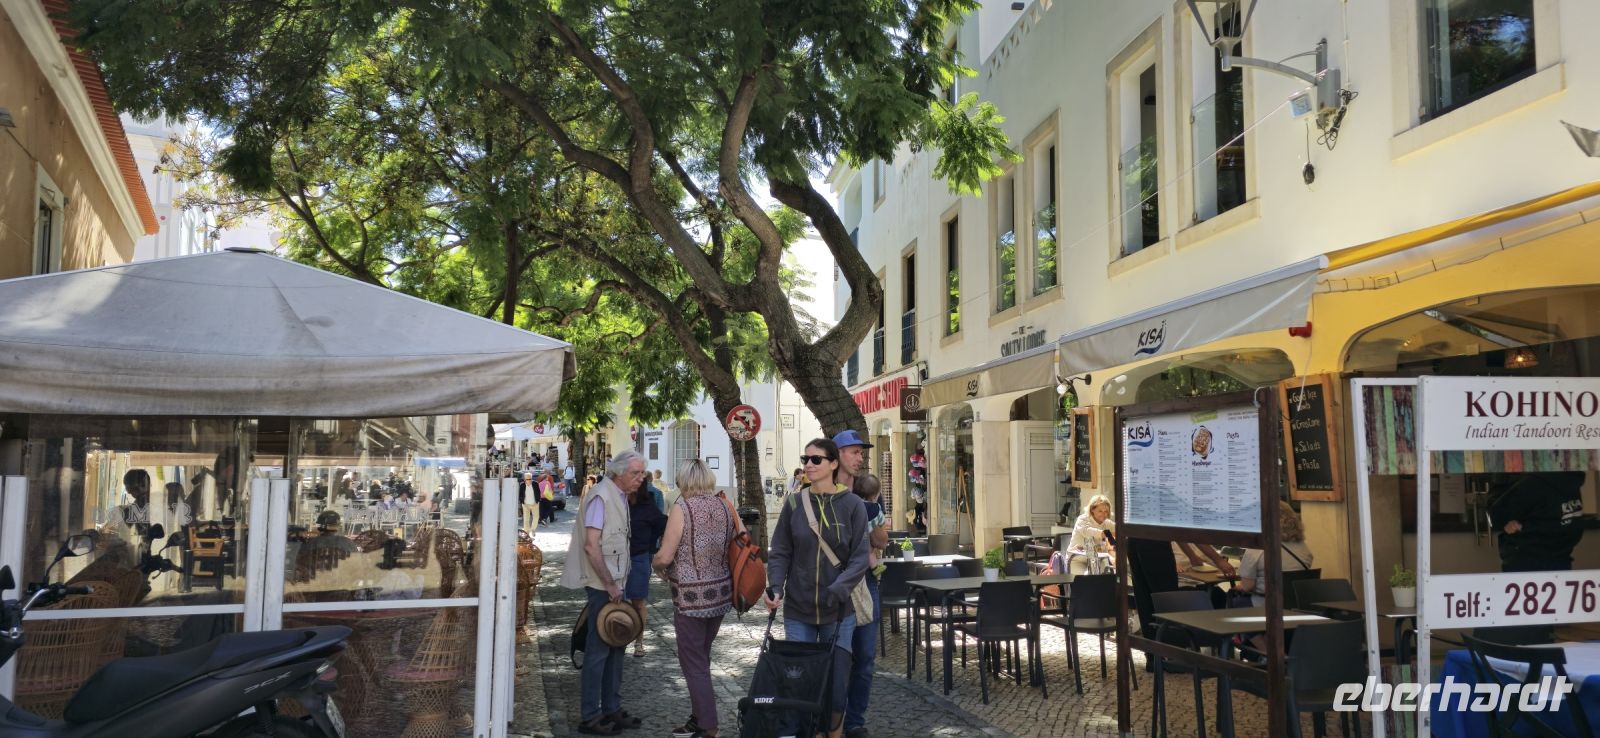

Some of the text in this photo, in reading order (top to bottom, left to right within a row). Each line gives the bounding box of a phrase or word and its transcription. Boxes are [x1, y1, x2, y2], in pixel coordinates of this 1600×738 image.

[1464, 391, 1599, 417] KOHINO
[1465, 422, 1509, 439] Indian
[1513, 421, 1571, 439] Tandoori
[1302, 459, 1320, 470] Pasta
[1444, 580, 1600, 618] Telf.: 282 76
